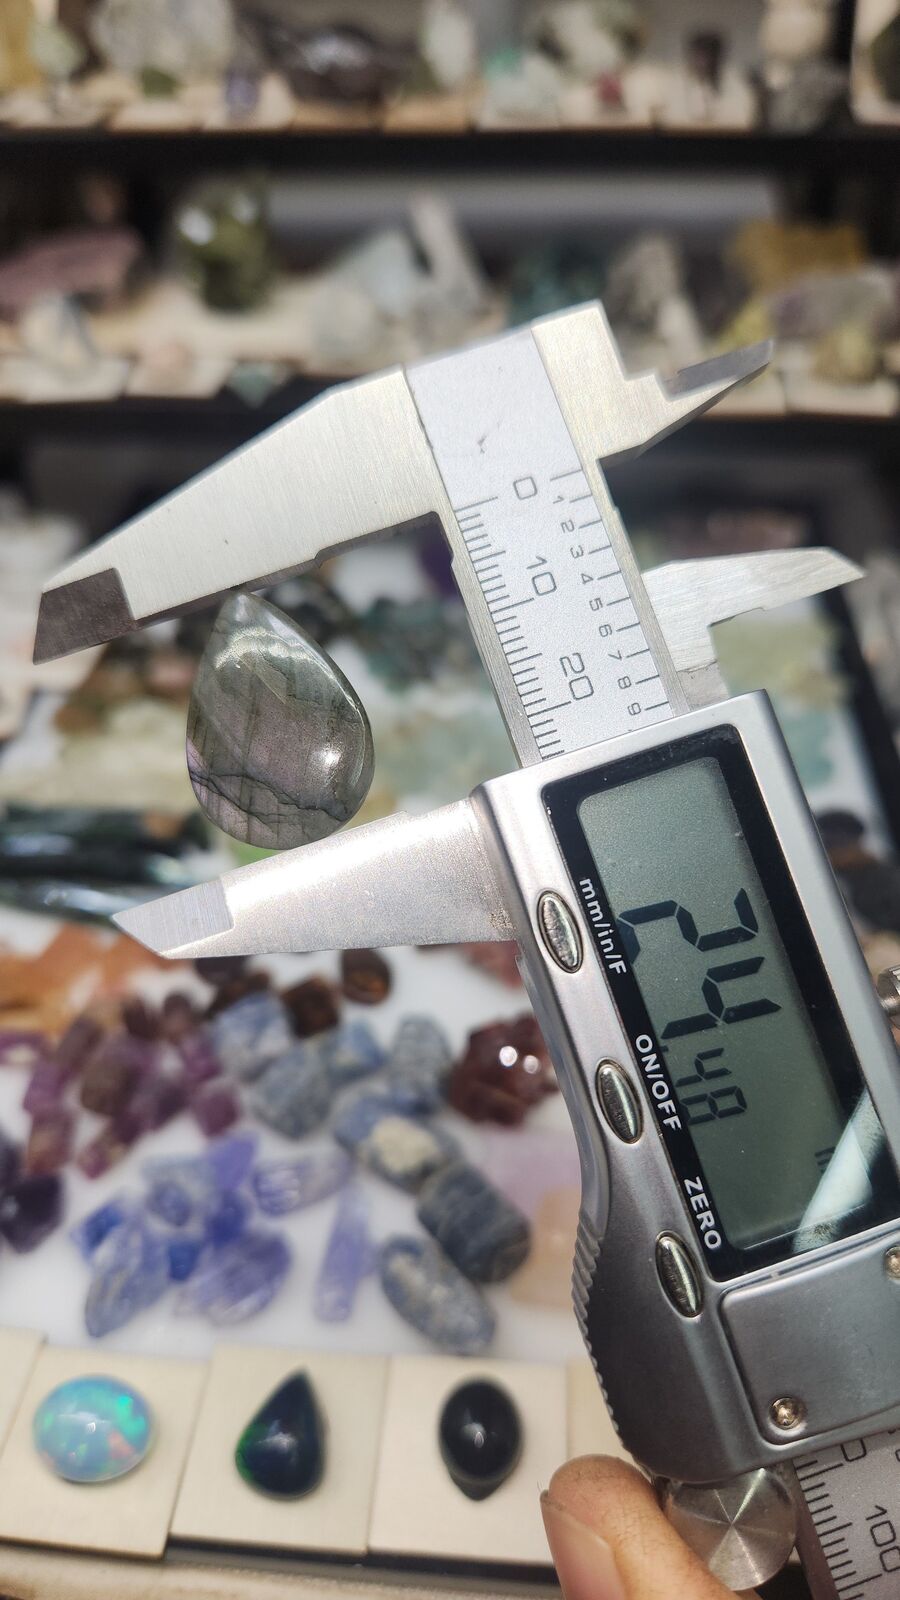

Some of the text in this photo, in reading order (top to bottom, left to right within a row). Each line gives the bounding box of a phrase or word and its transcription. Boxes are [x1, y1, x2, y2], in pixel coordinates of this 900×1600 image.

[513, 476, 538, 500] 0
[553, 495, 564, 504] 1
[560, 519, 575, 533] 2
[570, 545, 584, 559] 3
[526, 555, 557, 596] 10
[581, 573, 593, 585] 4
[589, 598, 603, 611] 5
[599, 624, 613, 638] 6
[608, 650, 622, 661] 7
[559, 652, 594, 701] 20
[618, 676, 632, 690] 8
[627, 702, 641, 716] 9
[579, 878, 627, 976] mm/in/F
[635, 1034, 682, 1131] ON/OFF
[684, 1176, 722, 1250] ZERO
[865, 1505, 900, 1573] 100
